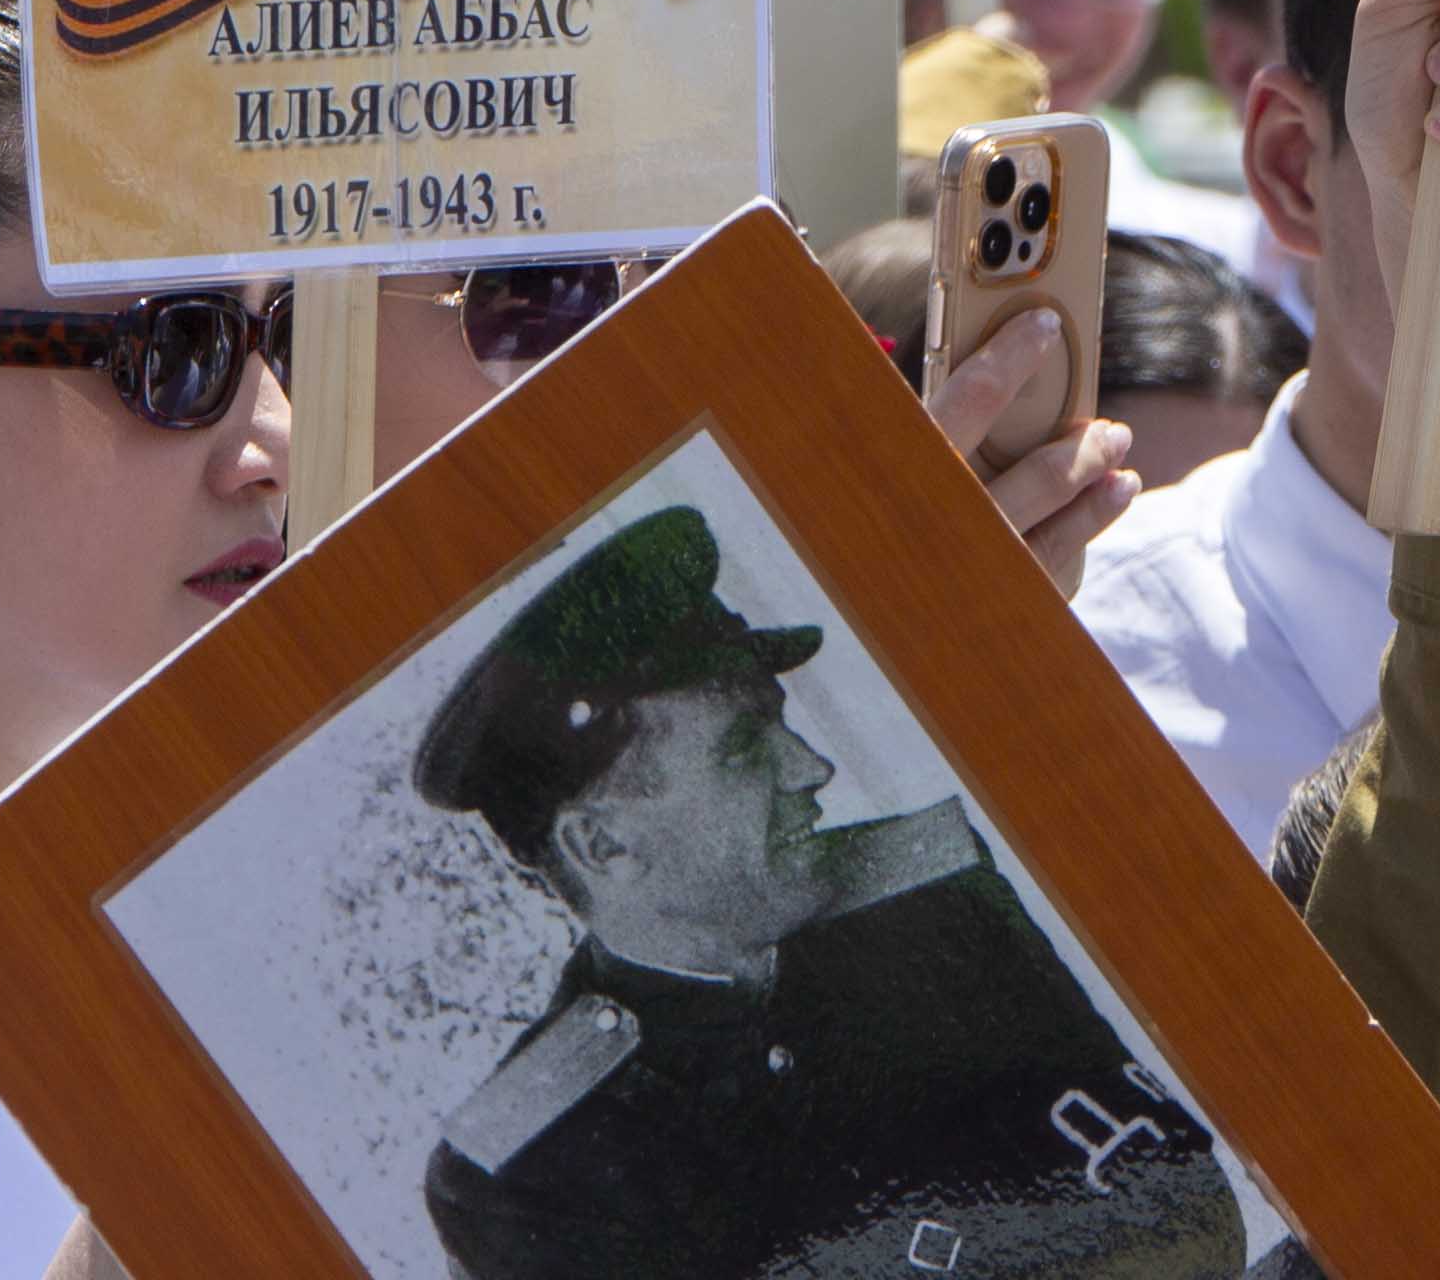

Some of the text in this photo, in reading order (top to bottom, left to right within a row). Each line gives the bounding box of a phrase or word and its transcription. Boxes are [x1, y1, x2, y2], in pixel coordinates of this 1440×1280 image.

[236, 73, 575, 142] ИЛЬЯСОВИЧ
[269, 172, 542, 236] 1917-1943 г.
